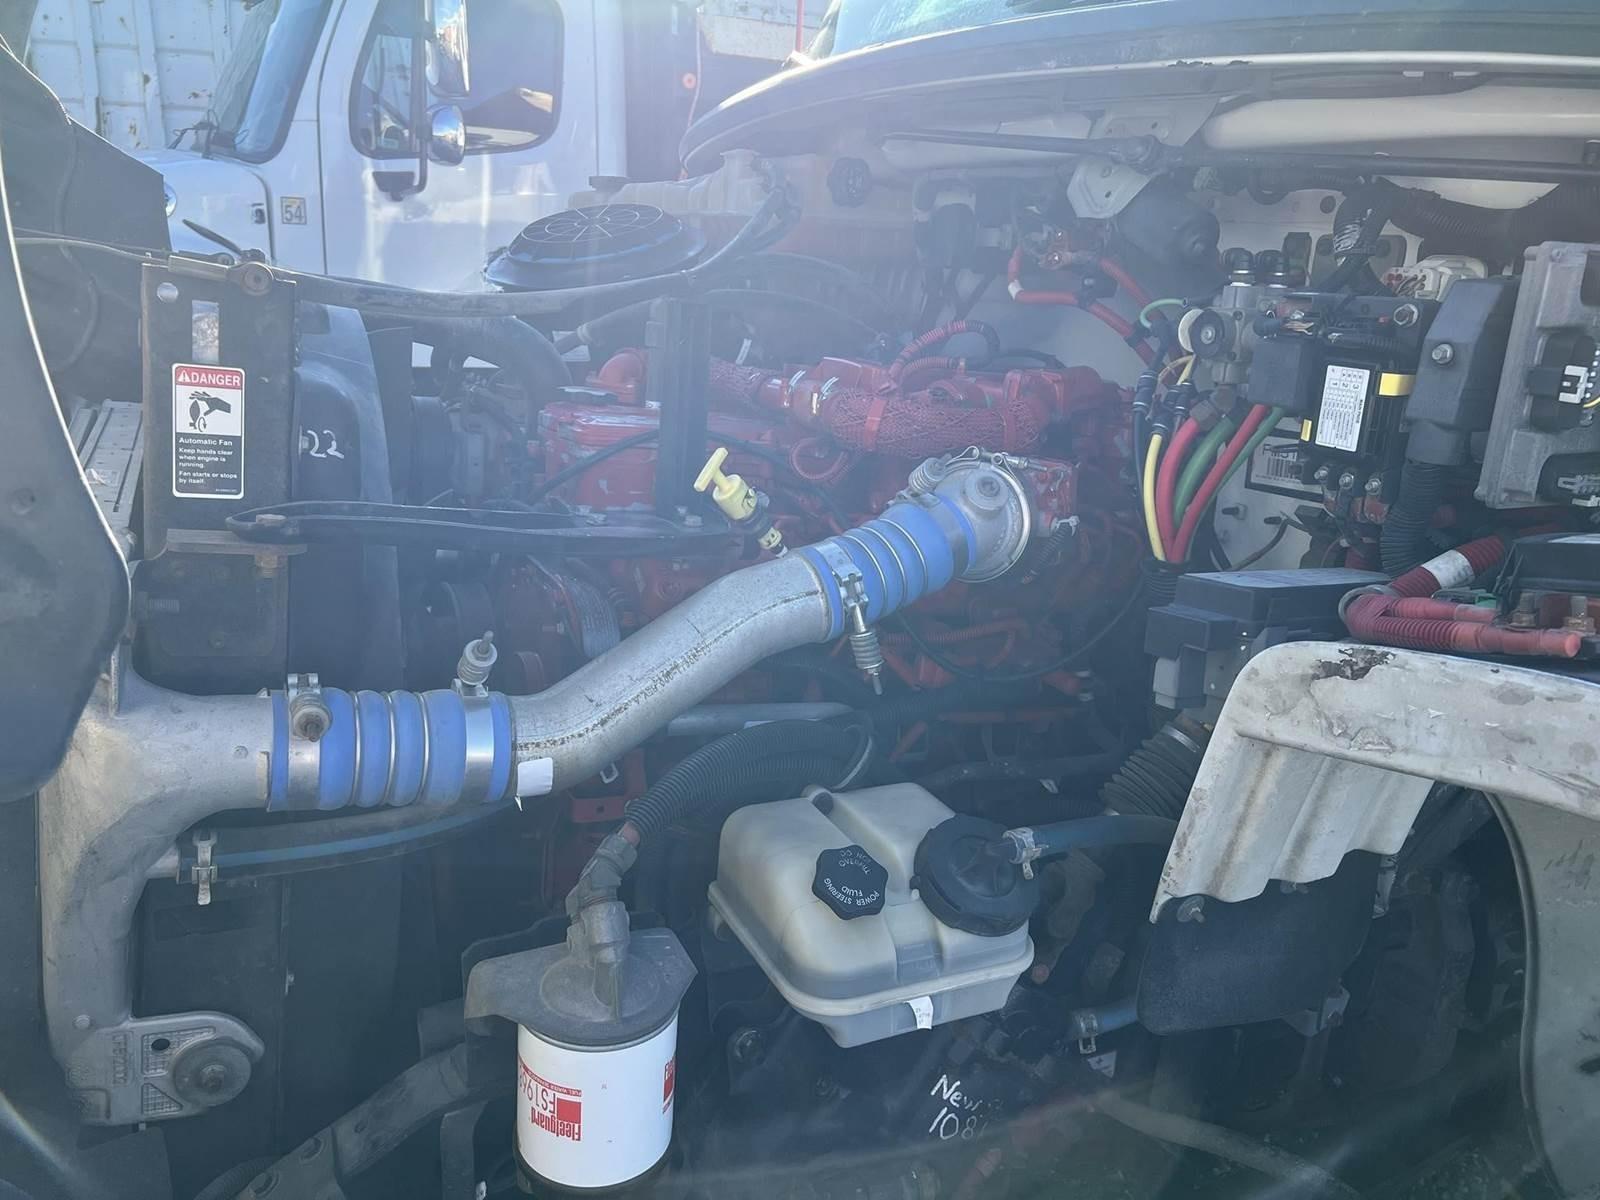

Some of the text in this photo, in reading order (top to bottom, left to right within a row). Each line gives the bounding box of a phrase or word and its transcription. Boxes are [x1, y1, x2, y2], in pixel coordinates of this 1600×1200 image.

[285, 204, 303, 222] 54
[191, 372, 241, 386] DANGER
[179, 437, 217, 446] Automatic
[307, 429, 345, 460] 22
[824, 878, 880, 906] POWER STEERING
[841, 886, 863, 897] FLUID
[520, 1068, 556, 1114] FS196
[531, 1106, 582, 1142] Fleetguard
